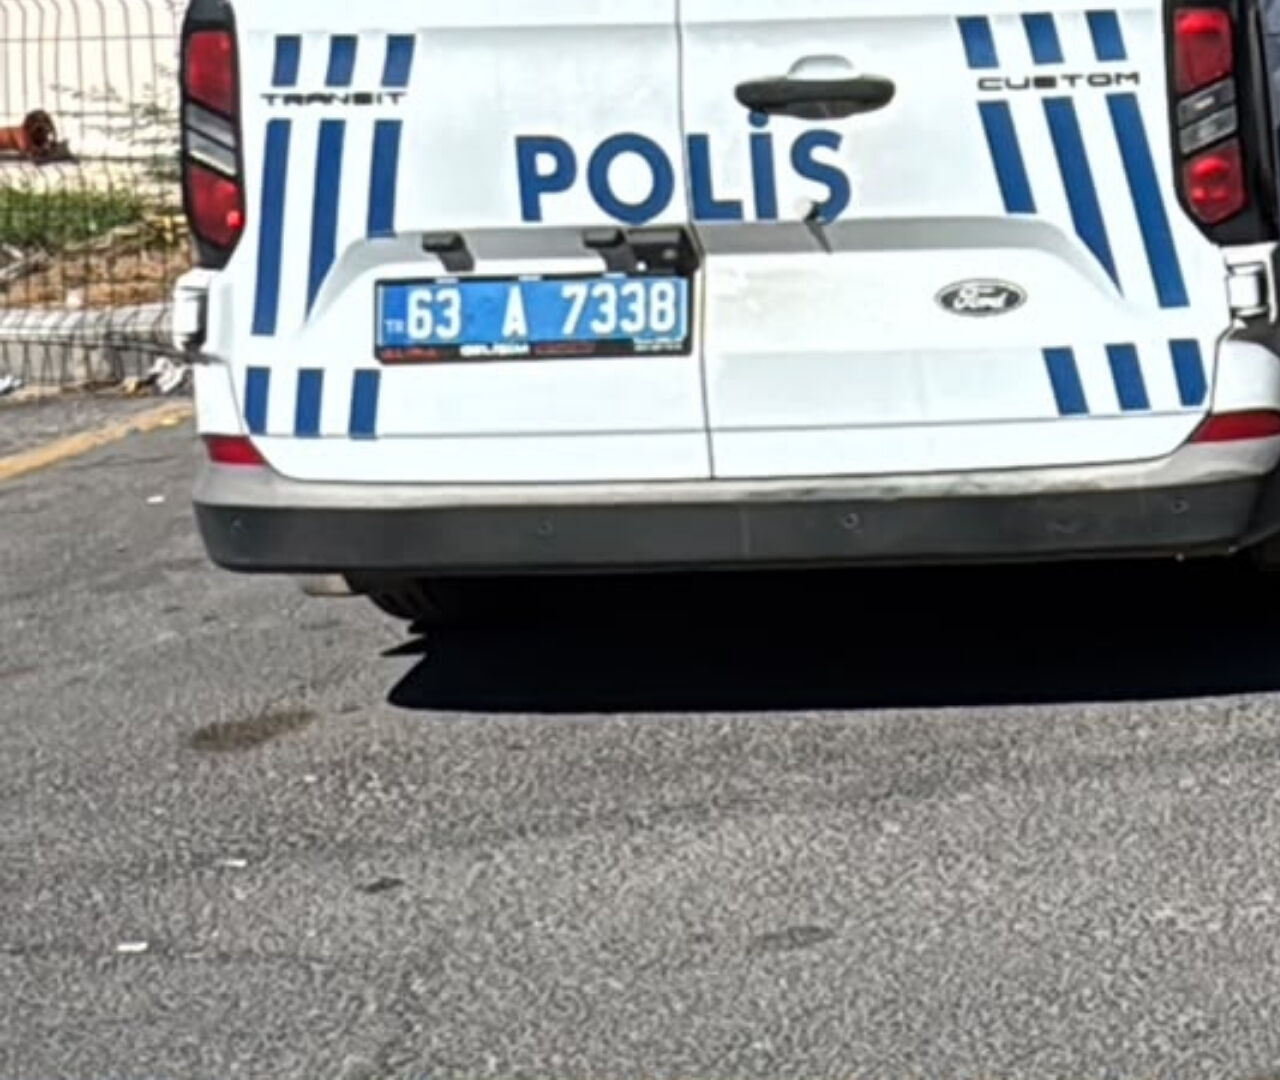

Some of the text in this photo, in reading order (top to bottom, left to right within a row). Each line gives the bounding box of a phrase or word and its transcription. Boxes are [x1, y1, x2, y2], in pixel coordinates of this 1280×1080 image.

[977, 72, 1140, 92] CUSTOM
[261, 92, 406, 106] TRANSIT
[407, 287, 461, 340] 63
[502, 285, 528, 337] A
[561, 280, 676, 336] 7338
